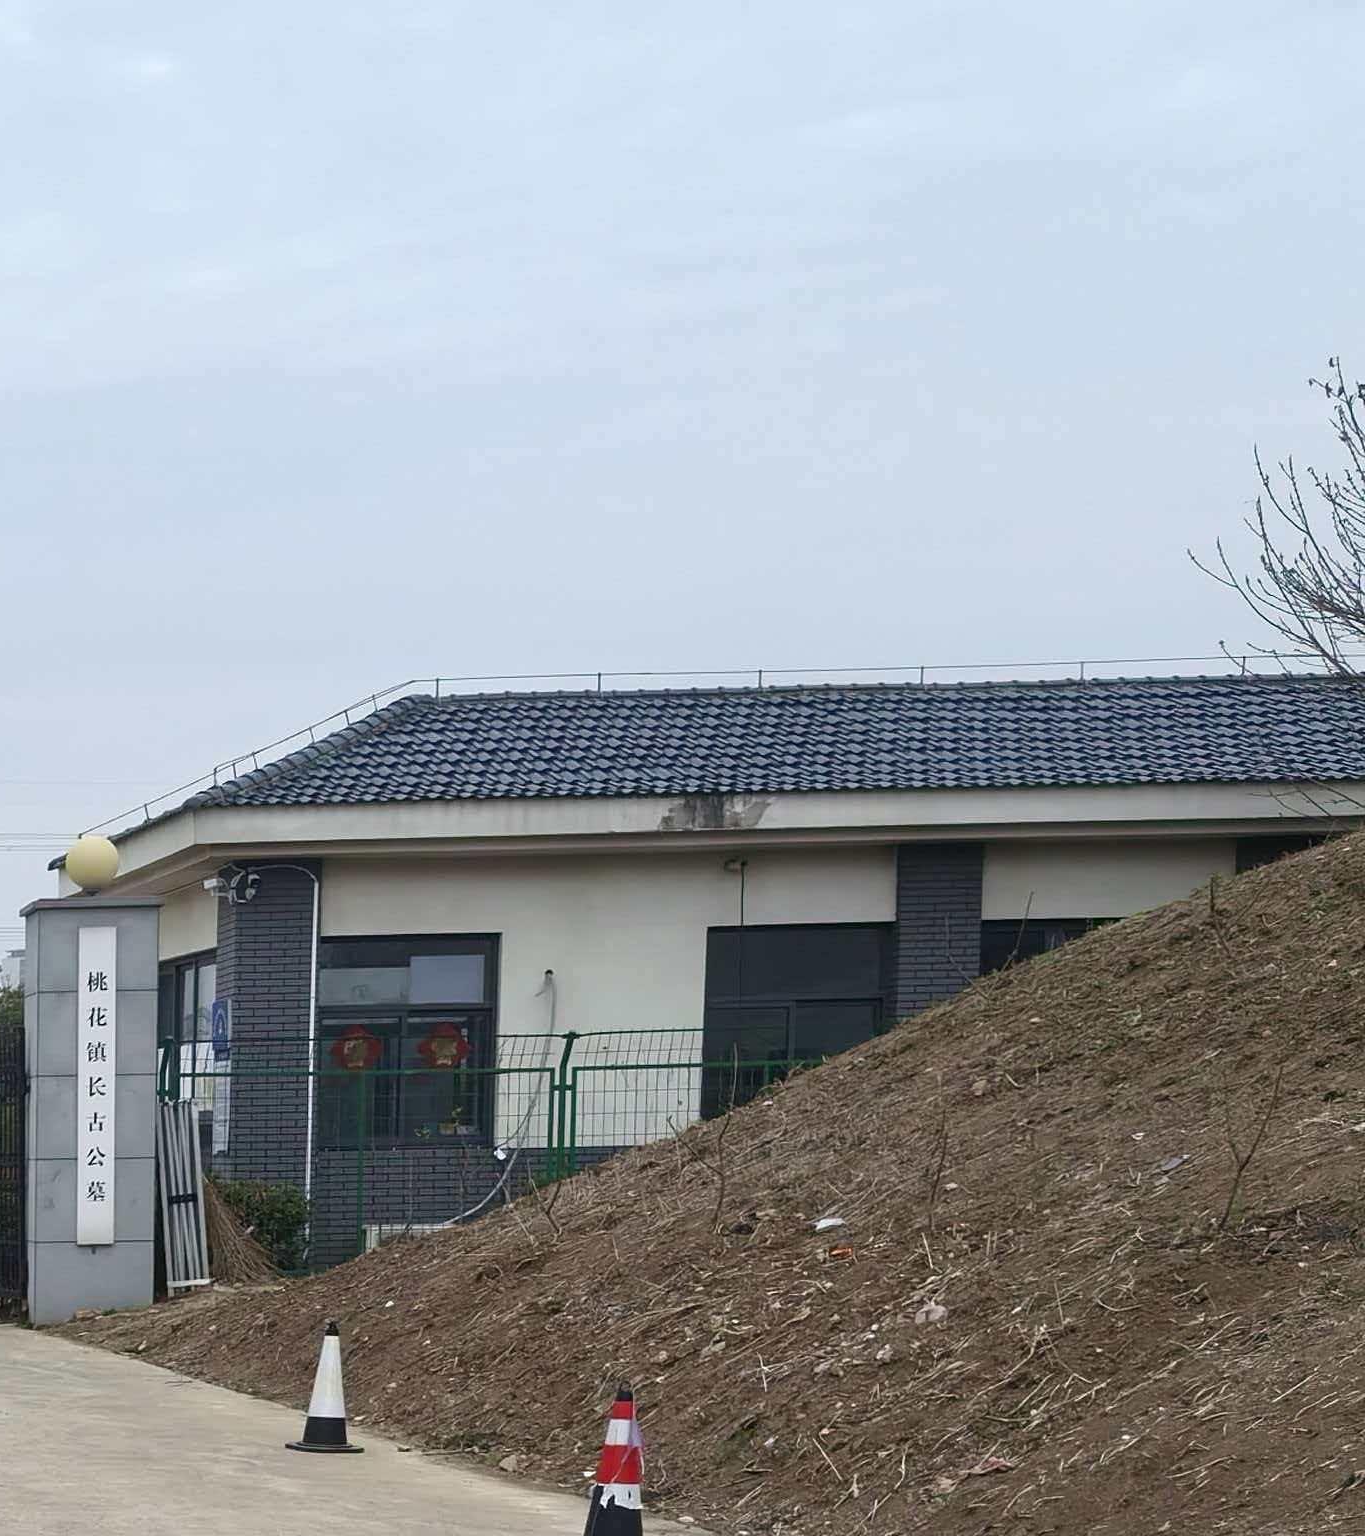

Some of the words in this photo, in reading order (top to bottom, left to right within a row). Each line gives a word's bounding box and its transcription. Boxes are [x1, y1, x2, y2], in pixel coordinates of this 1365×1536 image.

[85, 970, 109, 1203] 桃花镇长古公墓
